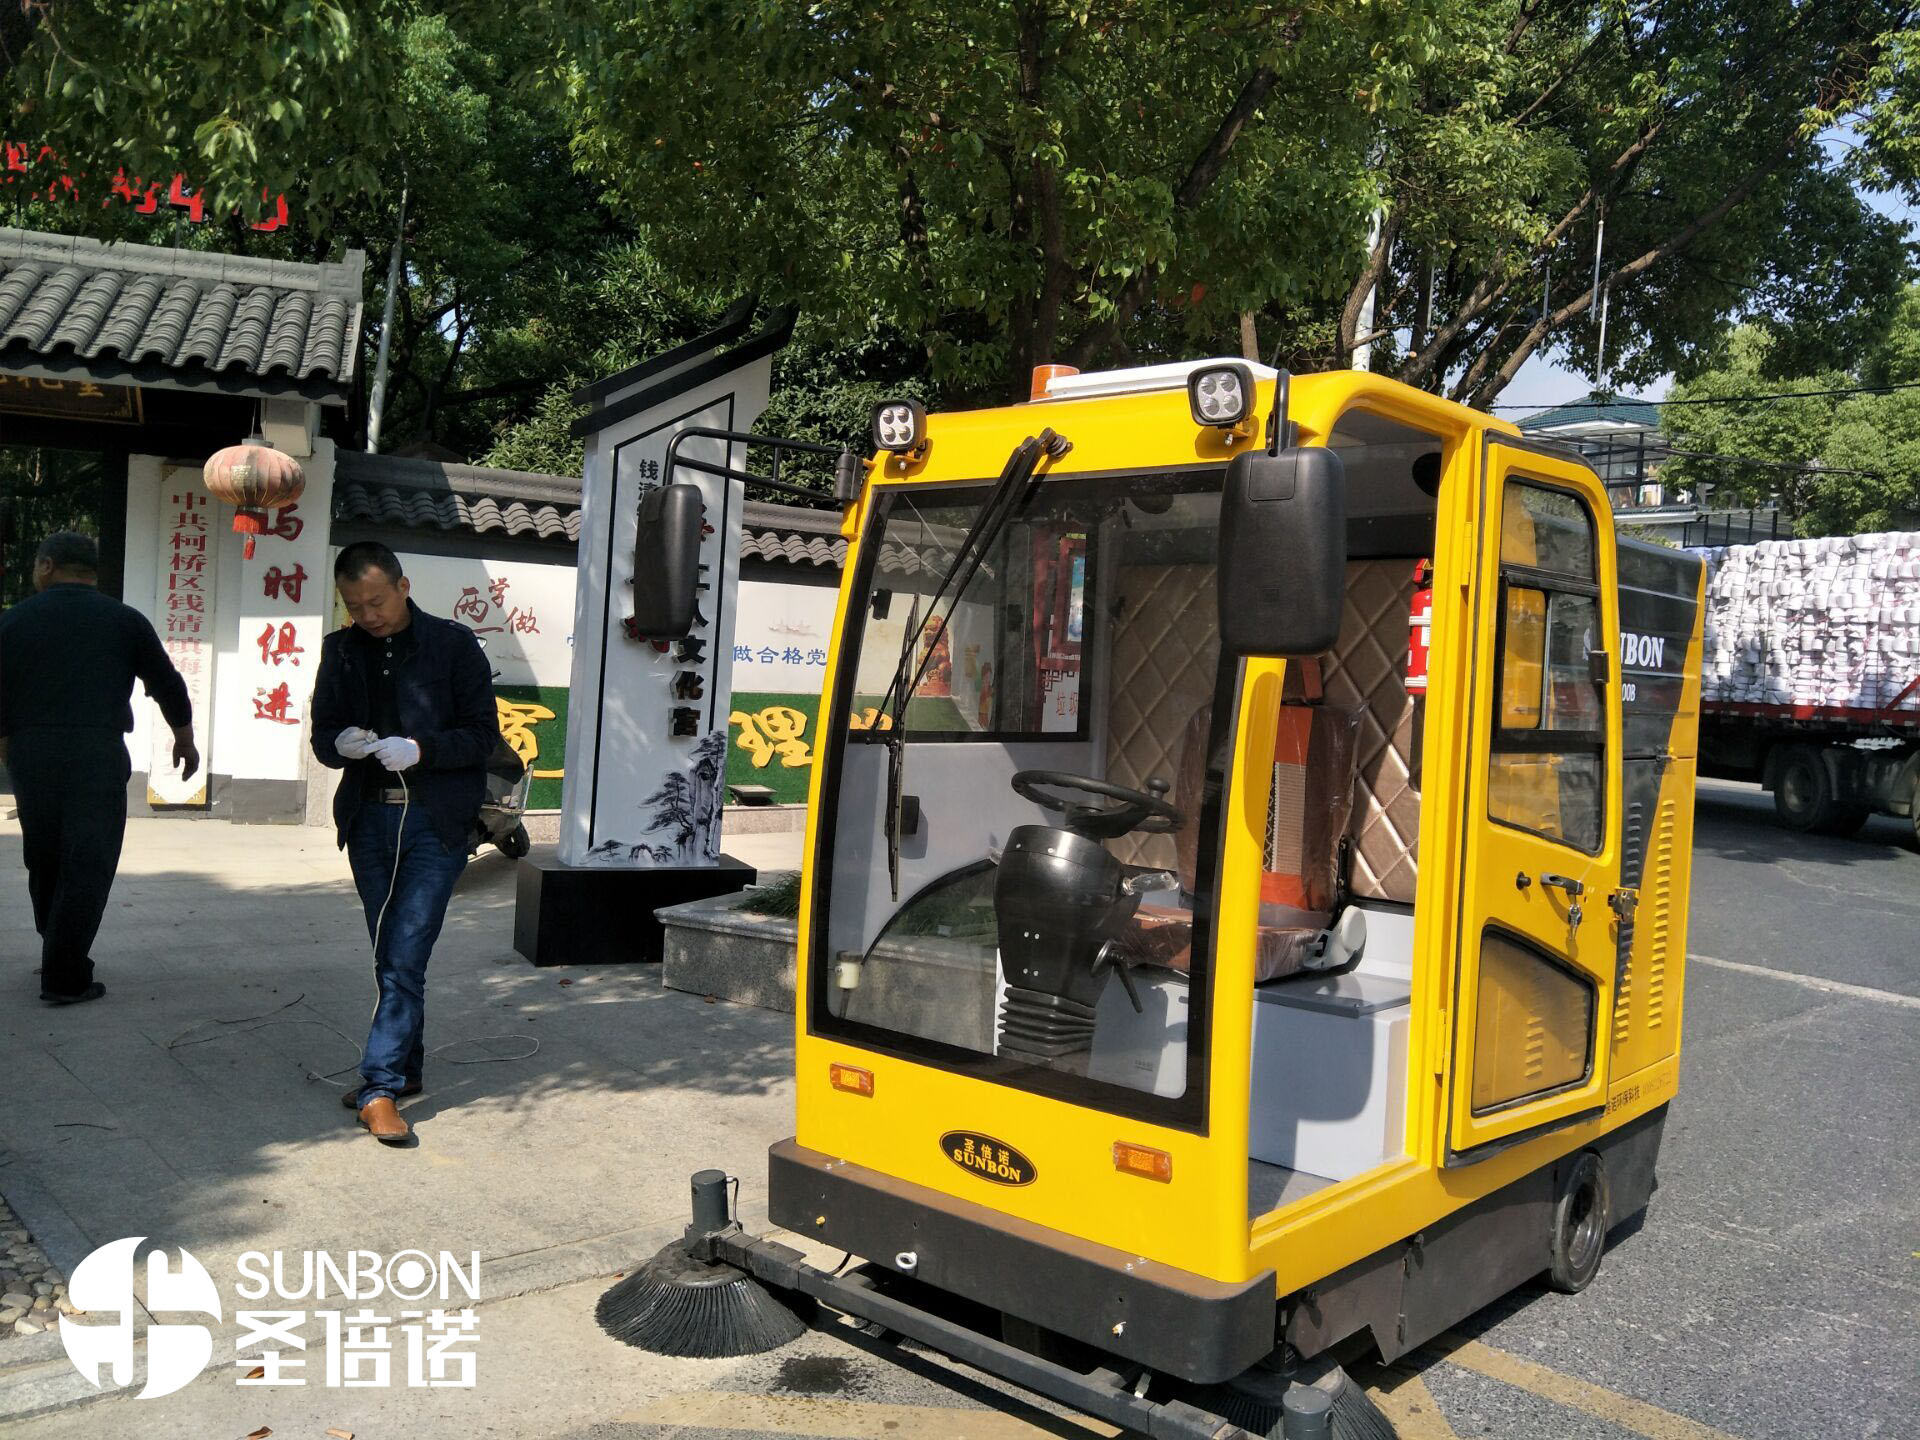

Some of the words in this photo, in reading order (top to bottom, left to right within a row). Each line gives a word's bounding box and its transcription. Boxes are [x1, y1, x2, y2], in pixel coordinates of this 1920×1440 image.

[253, 503, 308, 725] 与时俱进
[953, 1148, 1021, 1182] SUNBON
[964, 1138, 1010, 1166] 圣倍诺
